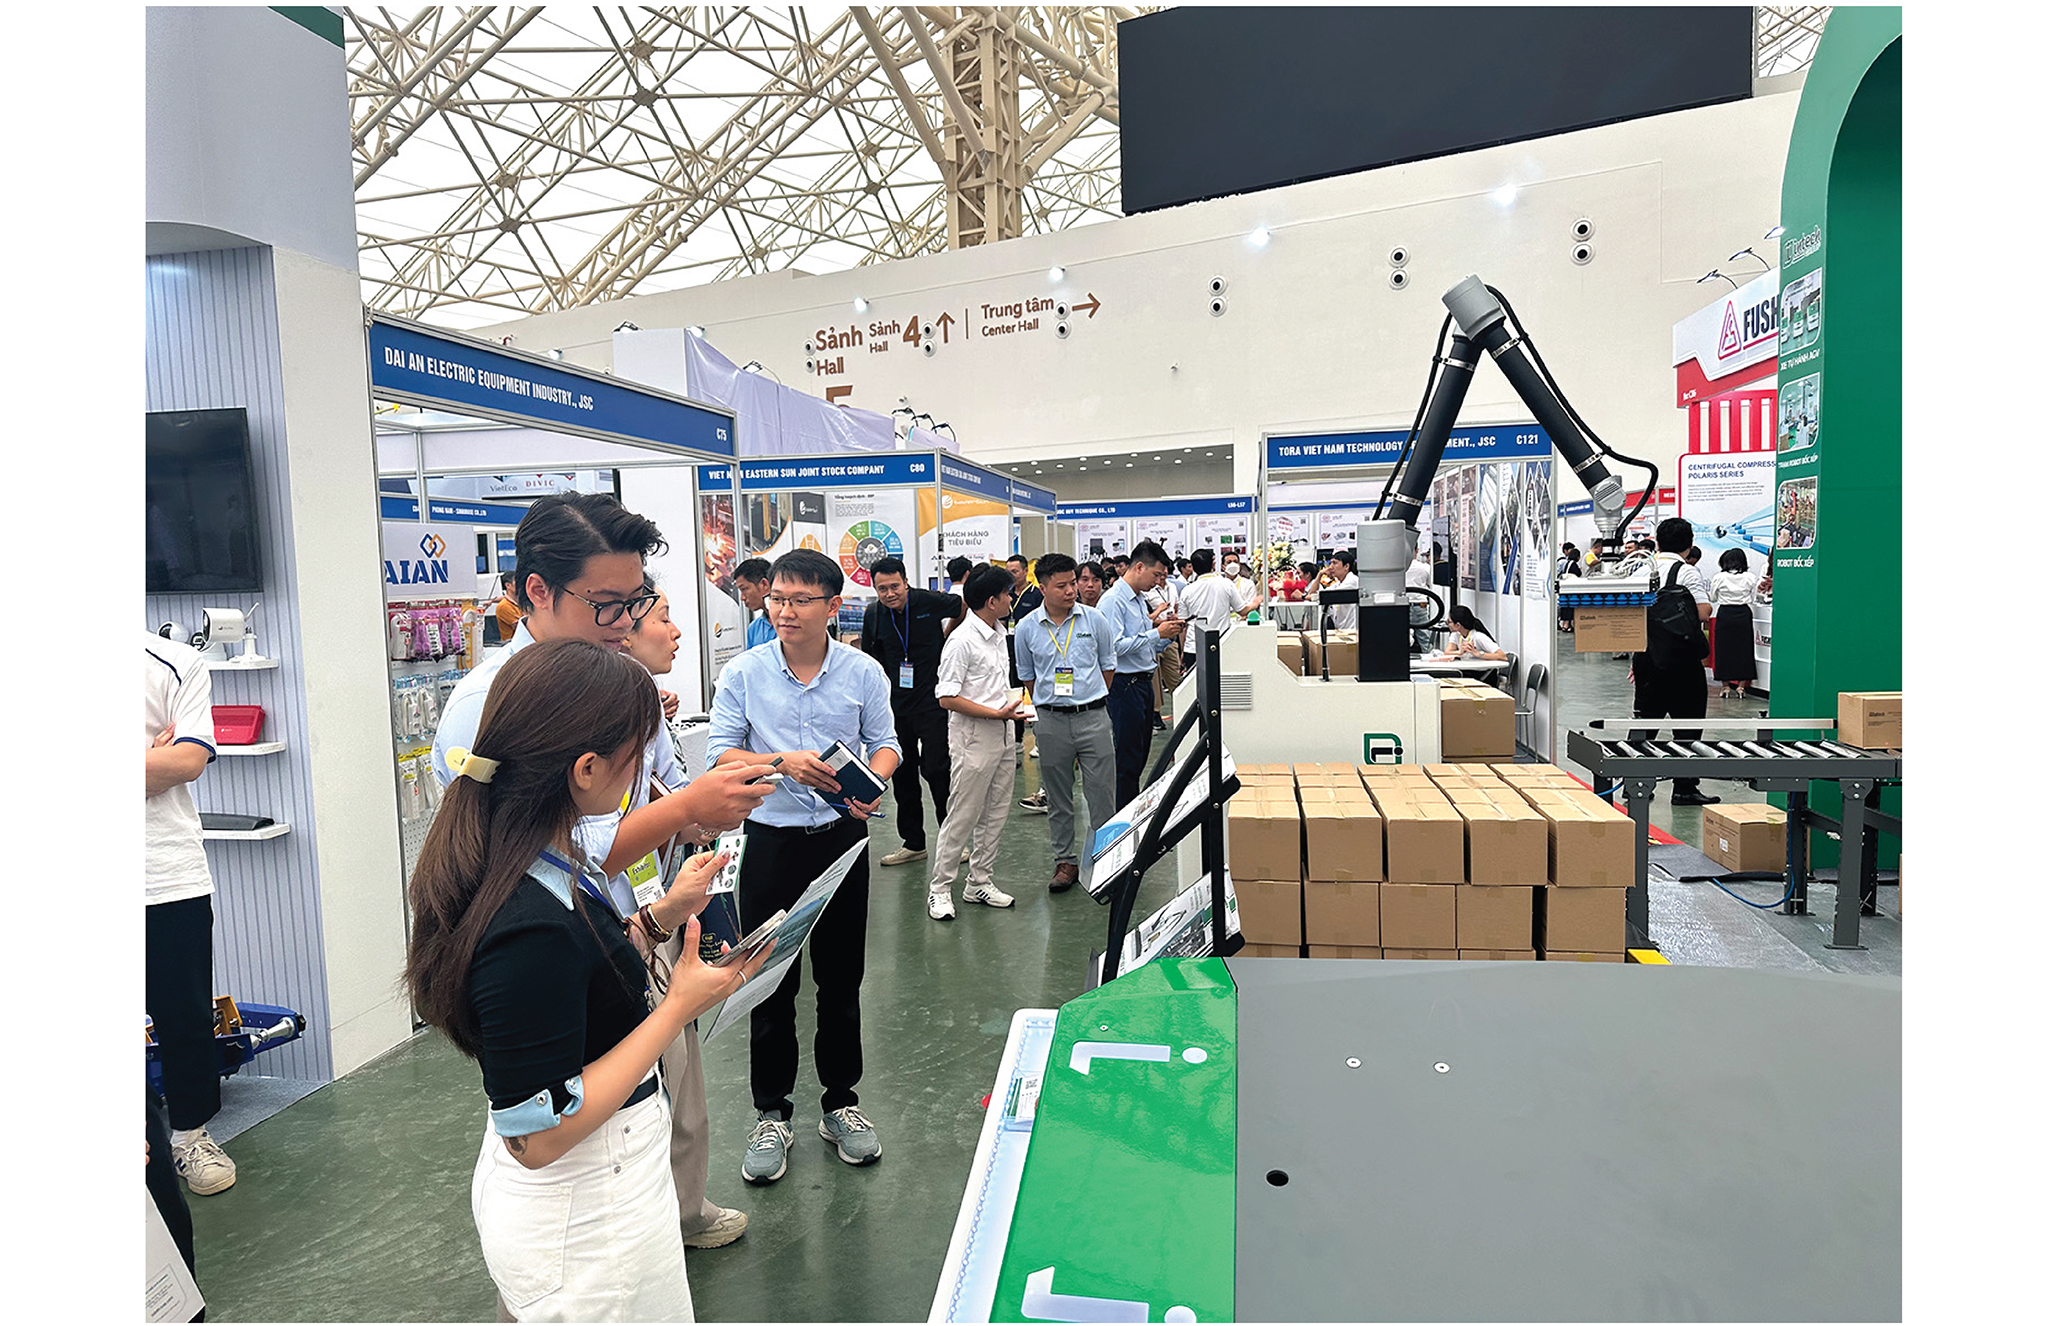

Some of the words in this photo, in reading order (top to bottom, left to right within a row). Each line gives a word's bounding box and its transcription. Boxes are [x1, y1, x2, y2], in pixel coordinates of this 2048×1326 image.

[981, 301, 1022, 319] Trung
[1025, 297, 1054, 313] tâm
[903, 315, 922, 348] 4
[982, 322, 1016, 337] Center
[1018, 318, 1039, 331] Hall
[816, 325, 863, 351] Sảnh
[870, 341, 888, 353] Hall
[816, 357, 844, 376] Hall
[384, 346, 405, 368] DAI
[408, 354, 425, 373] AN
[427, 357, 475, 385] ELECTRIC
[478, 369, 531, 397] EQUIPMENT
[578, 395, 594, 411] JSC
[716, 427, 727, 442] C75
[1516, 434, 1539, 445] C121
[1278, 446, 1301, 457] TORA
[1302, 445, 1323, 456] VIET
[1324, 444, 1344, 454] NAM
[1346, 441, 1403, 453] TECHNOLOGY
[1478, 436, 1496, 447] JSC
[708, 470, 725, 480] VIET
[745, 466, 779, 479] EASTERN
[780, 466, 796, 478] SUN
[798, 465, 819, 477] JOINT
[820, 465, 846, 476] STOCK
[847, 465, 884, 475] COMPANY
[1688, 462, 1736, 471] CENTRIFUGAL
[1720, 470, 1744, 478] SERIES
